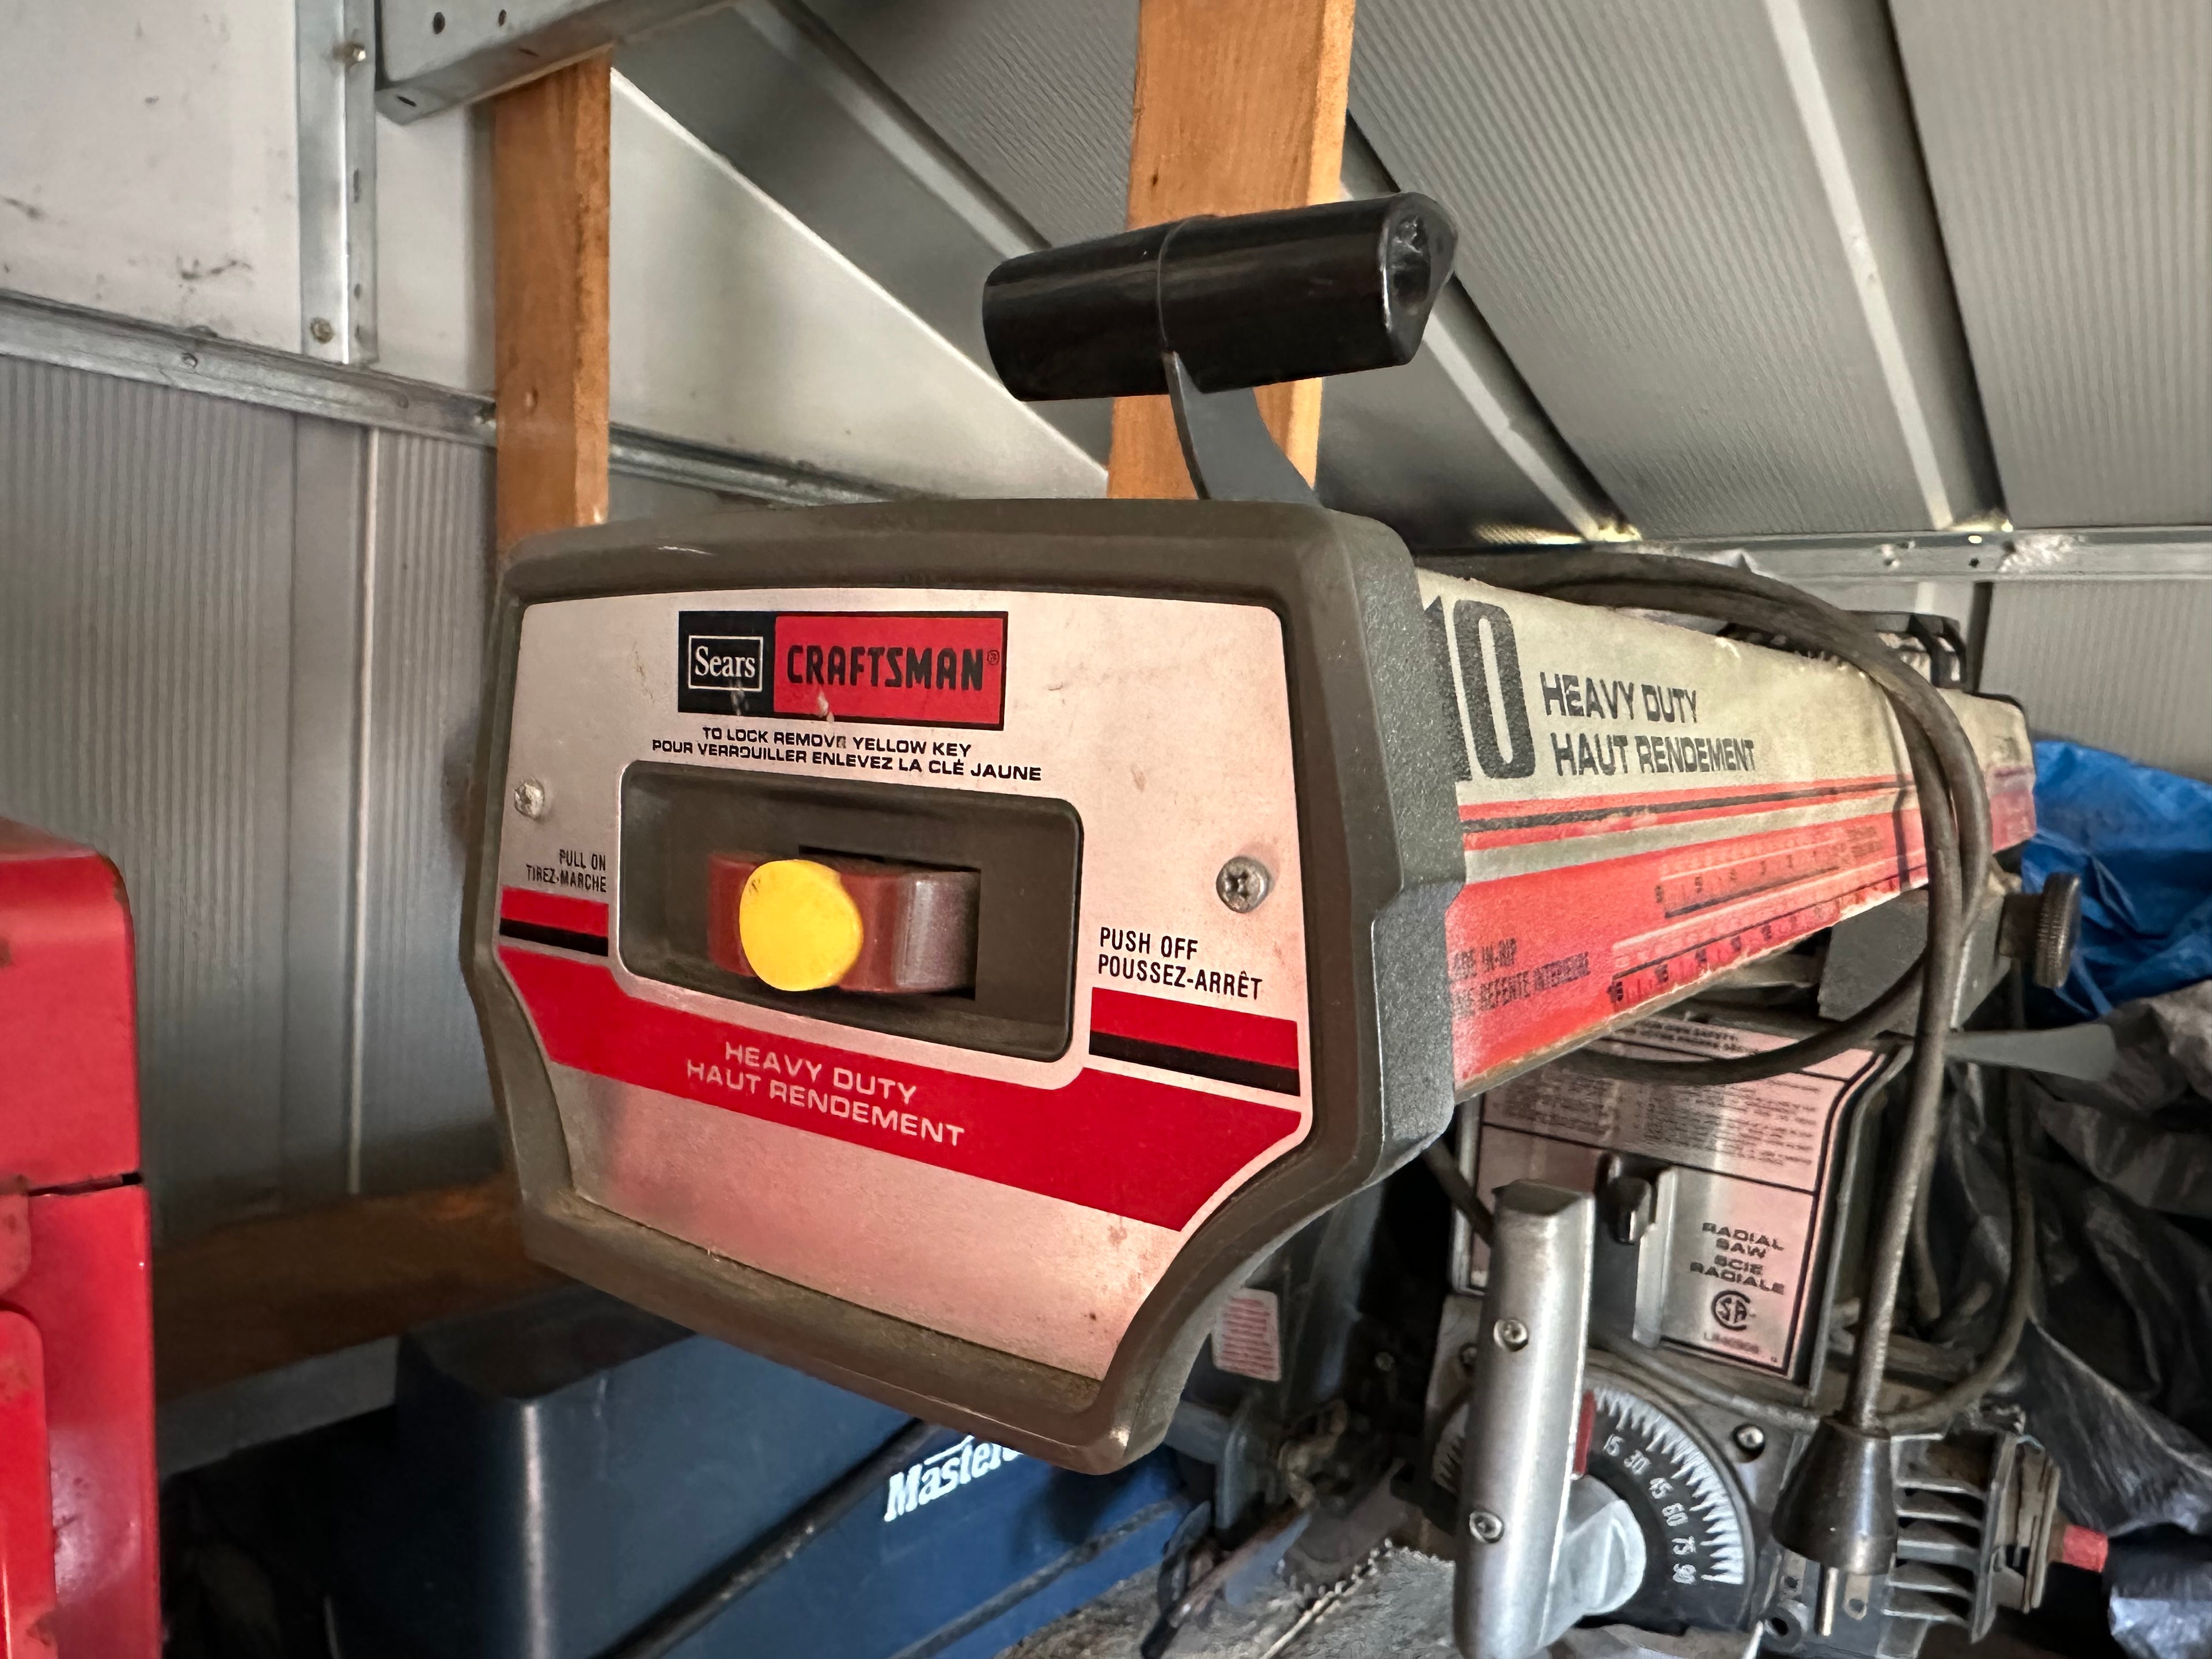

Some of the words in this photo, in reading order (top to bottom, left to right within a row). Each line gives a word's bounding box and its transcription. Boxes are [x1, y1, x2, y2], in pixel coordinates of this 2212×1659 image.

[695, 646, 756, 677] Sears
[1540, 671, 1635, 720] HEAVY
[1641, 683, 1698, 723] DUTY
[702, 727, 722, 740] TO
[727, 729, 768, 743] LOCK
[853, 737, 926, 755] YELLOW
[933, 741, 971, 757] KEY
[1550, 732, 1628, 776] HAUT
[1635, 735, 1756, 774] RENDEMENT
[652, 739, 693, 754] POUR
[698, 743, 807, 764] VERROUILLER
[812, 751, 893, 770] ENLEVEZ
[899, 757, 922, 772] LA
[929, 759, 964, 775] CLÉ
[970, 763, 1041, 781] JAUNE
[559, 849, 586, 869] PULL
[591, 853, 606, 872] ON
[1100, 926, 1151, 954] PUSH
[1161, 935, 1198, 960] OFF
[1098, 953, 1263, 1001] POUSSEZ-ARRÊT
[725, 1041, 822, 1083] HEAVY
[833, 1067, 917, 1105] DUTY
[687, 1059, 762, 1094] HAUT
[770, 1079, 965, 1146] RENDEMENT
[1702, 1222, 1785, 1251] RADIAL
[1716, 1238, 1766, 1259] SAW
[1690, 1262, 1785, 1296] RADIALE
[1714, 1255, 1763, 1275] SCIE
[1603, 1433, 1626, 1457] 15
[1623, 1449, 1652, 1475] 30
